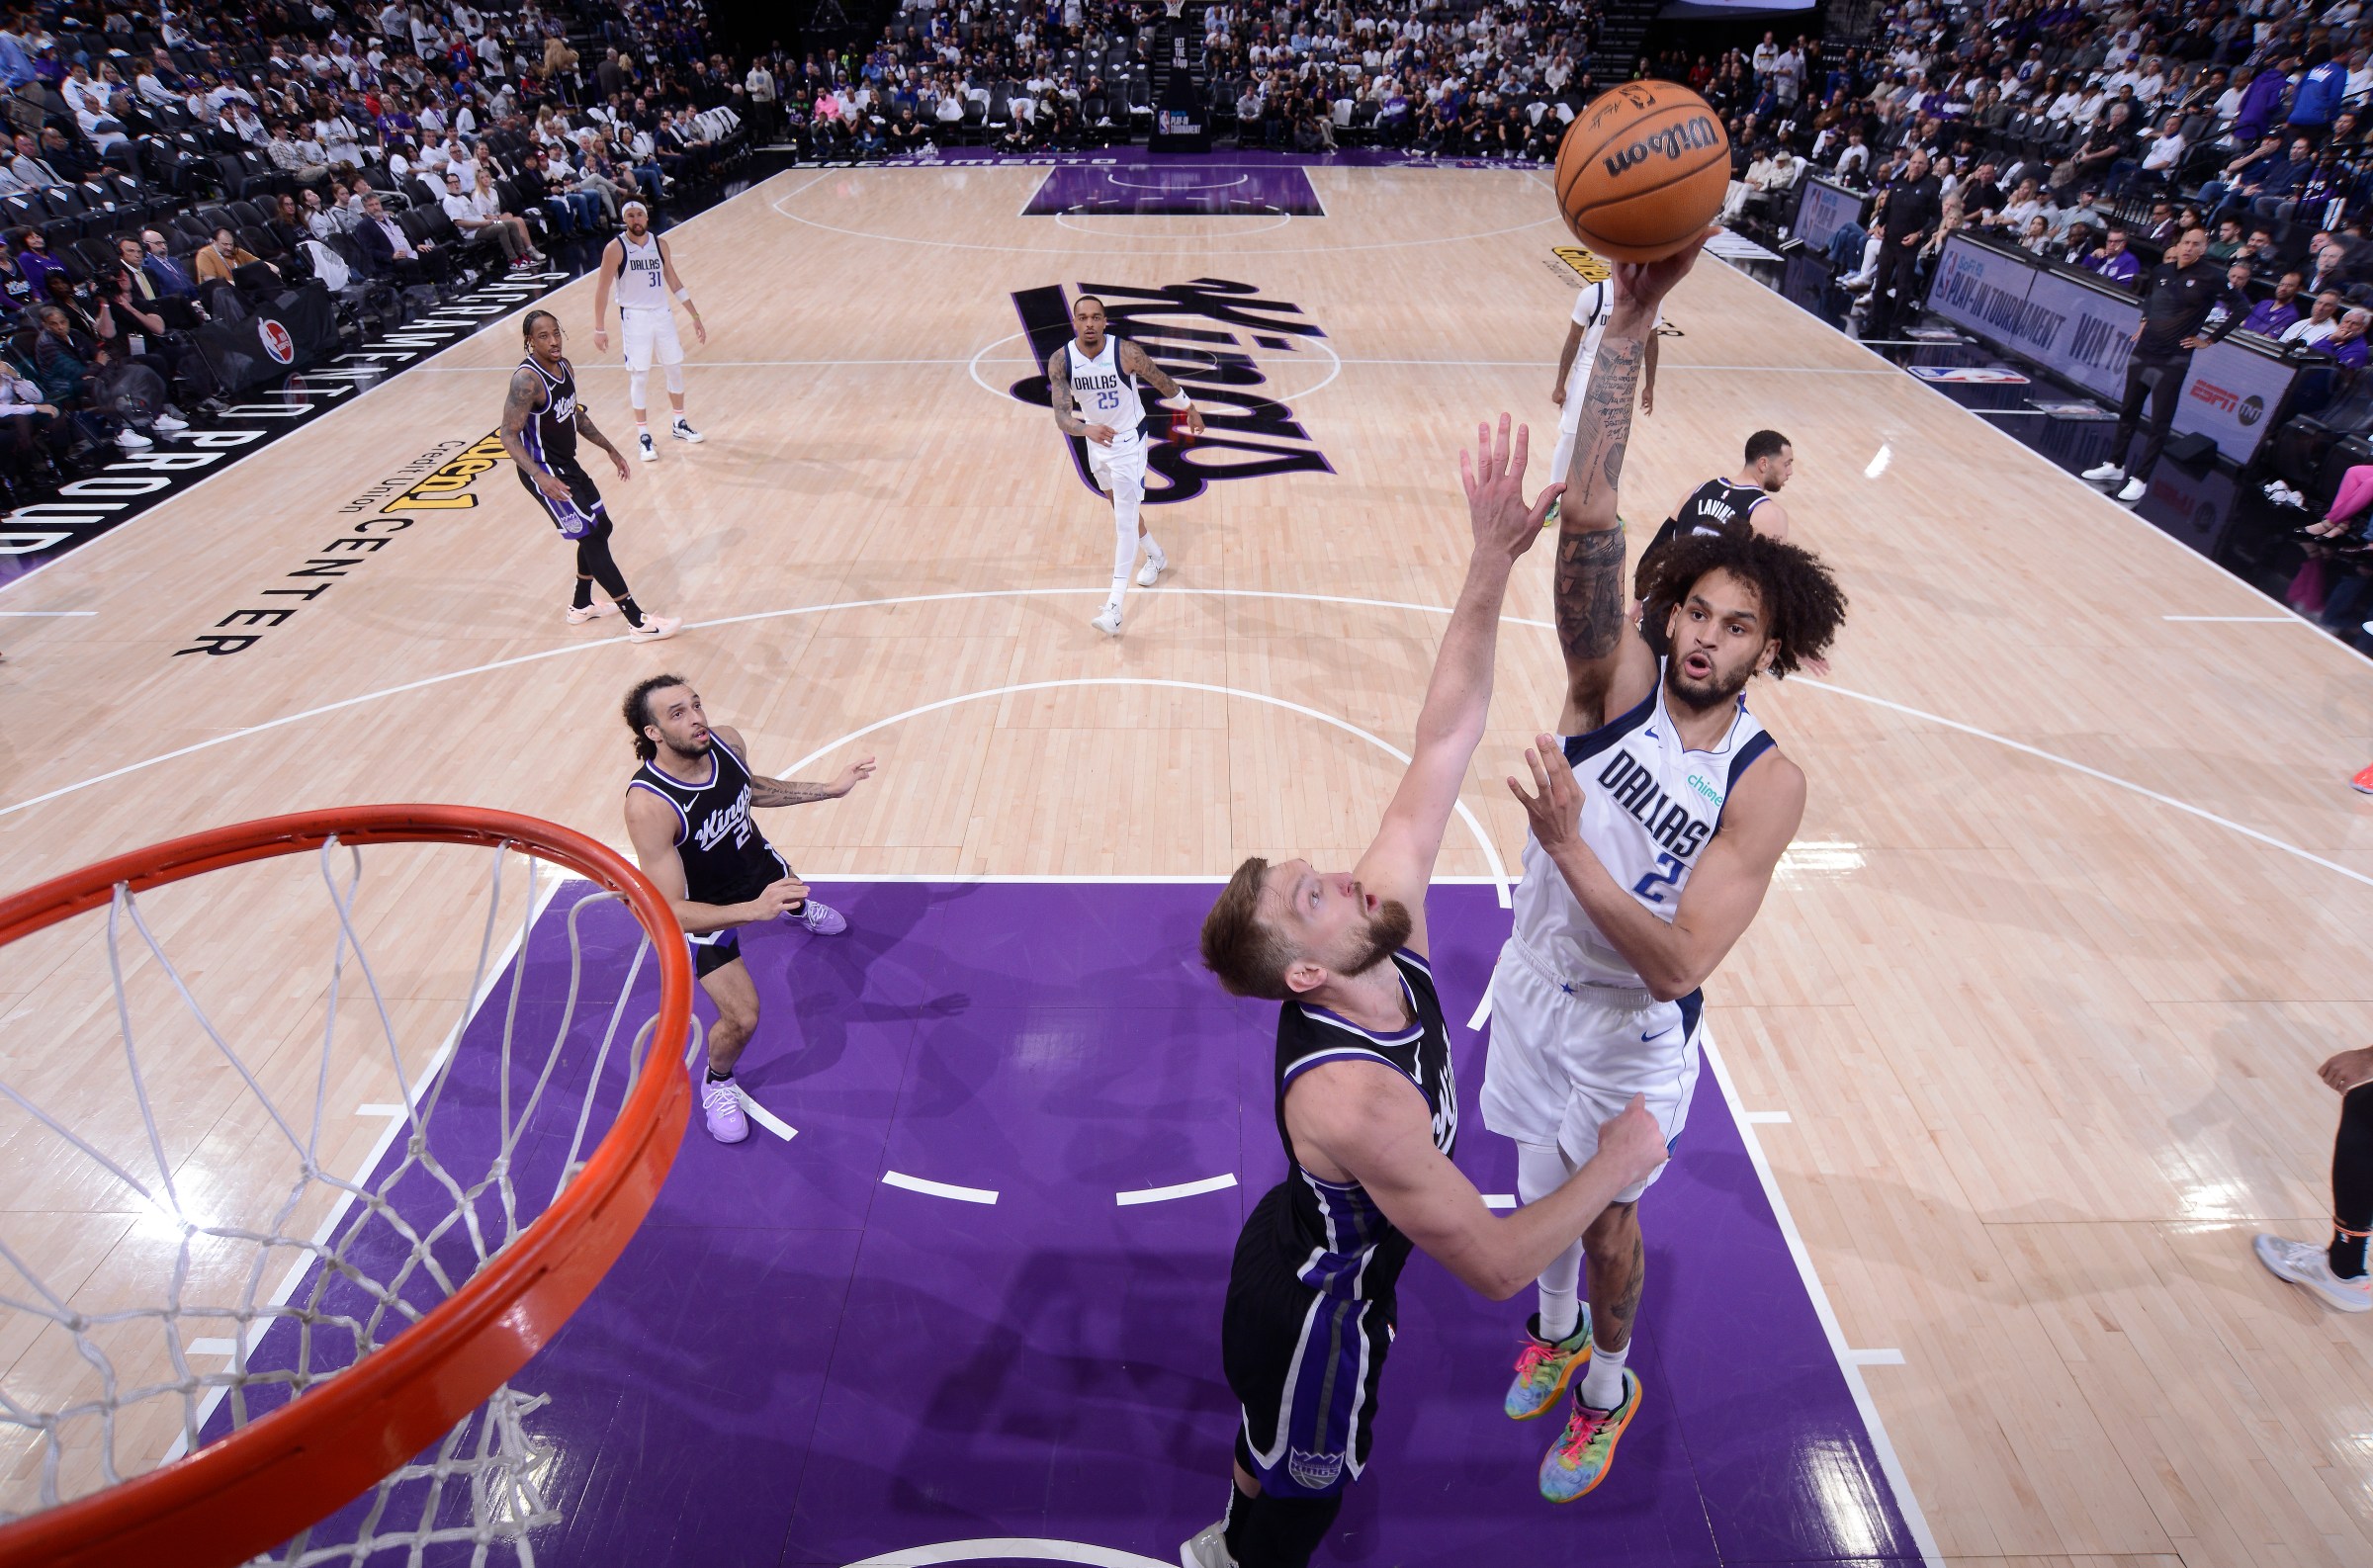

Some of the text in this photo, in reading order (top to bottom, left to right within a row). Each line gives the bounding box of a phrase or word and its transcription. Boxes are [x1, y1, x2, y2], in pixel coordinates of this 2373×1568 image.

[1174, 38, 1186, 47] GET
[1175, 47, 1186, 57] THE
[792, 158, 1118, 168] SACRAMENTO
[1602, 116, 1719, 177] Wilson
[630, 258, 660, 271] DALLAS
[648, 271, 661, 288] 31
[1946, 273, 1991, 316] PLAY-IN
[1982, 284, 2067, 350] TOURNAMENT
[2068, 312, 2115, 369] WIN
[218, 272, 571, 417] SACRAMENTO
[1074, 374, 1117, 391] DALLAS
[2190, 379, 2240, 413] ESPN
[1098, 391, 1119, 410] 25
[2239, 402, 2263, 421] TNT
[338, 440, 467, 514] Credit Union
[171, 518, 414, 656] CENTER
[1597, 748, 1711, 859] DALLAS
[1687, 773, 1723, 807] chime
[694, 783, 752, 851] Kings
[1633, 851, 1686, 904] 2
